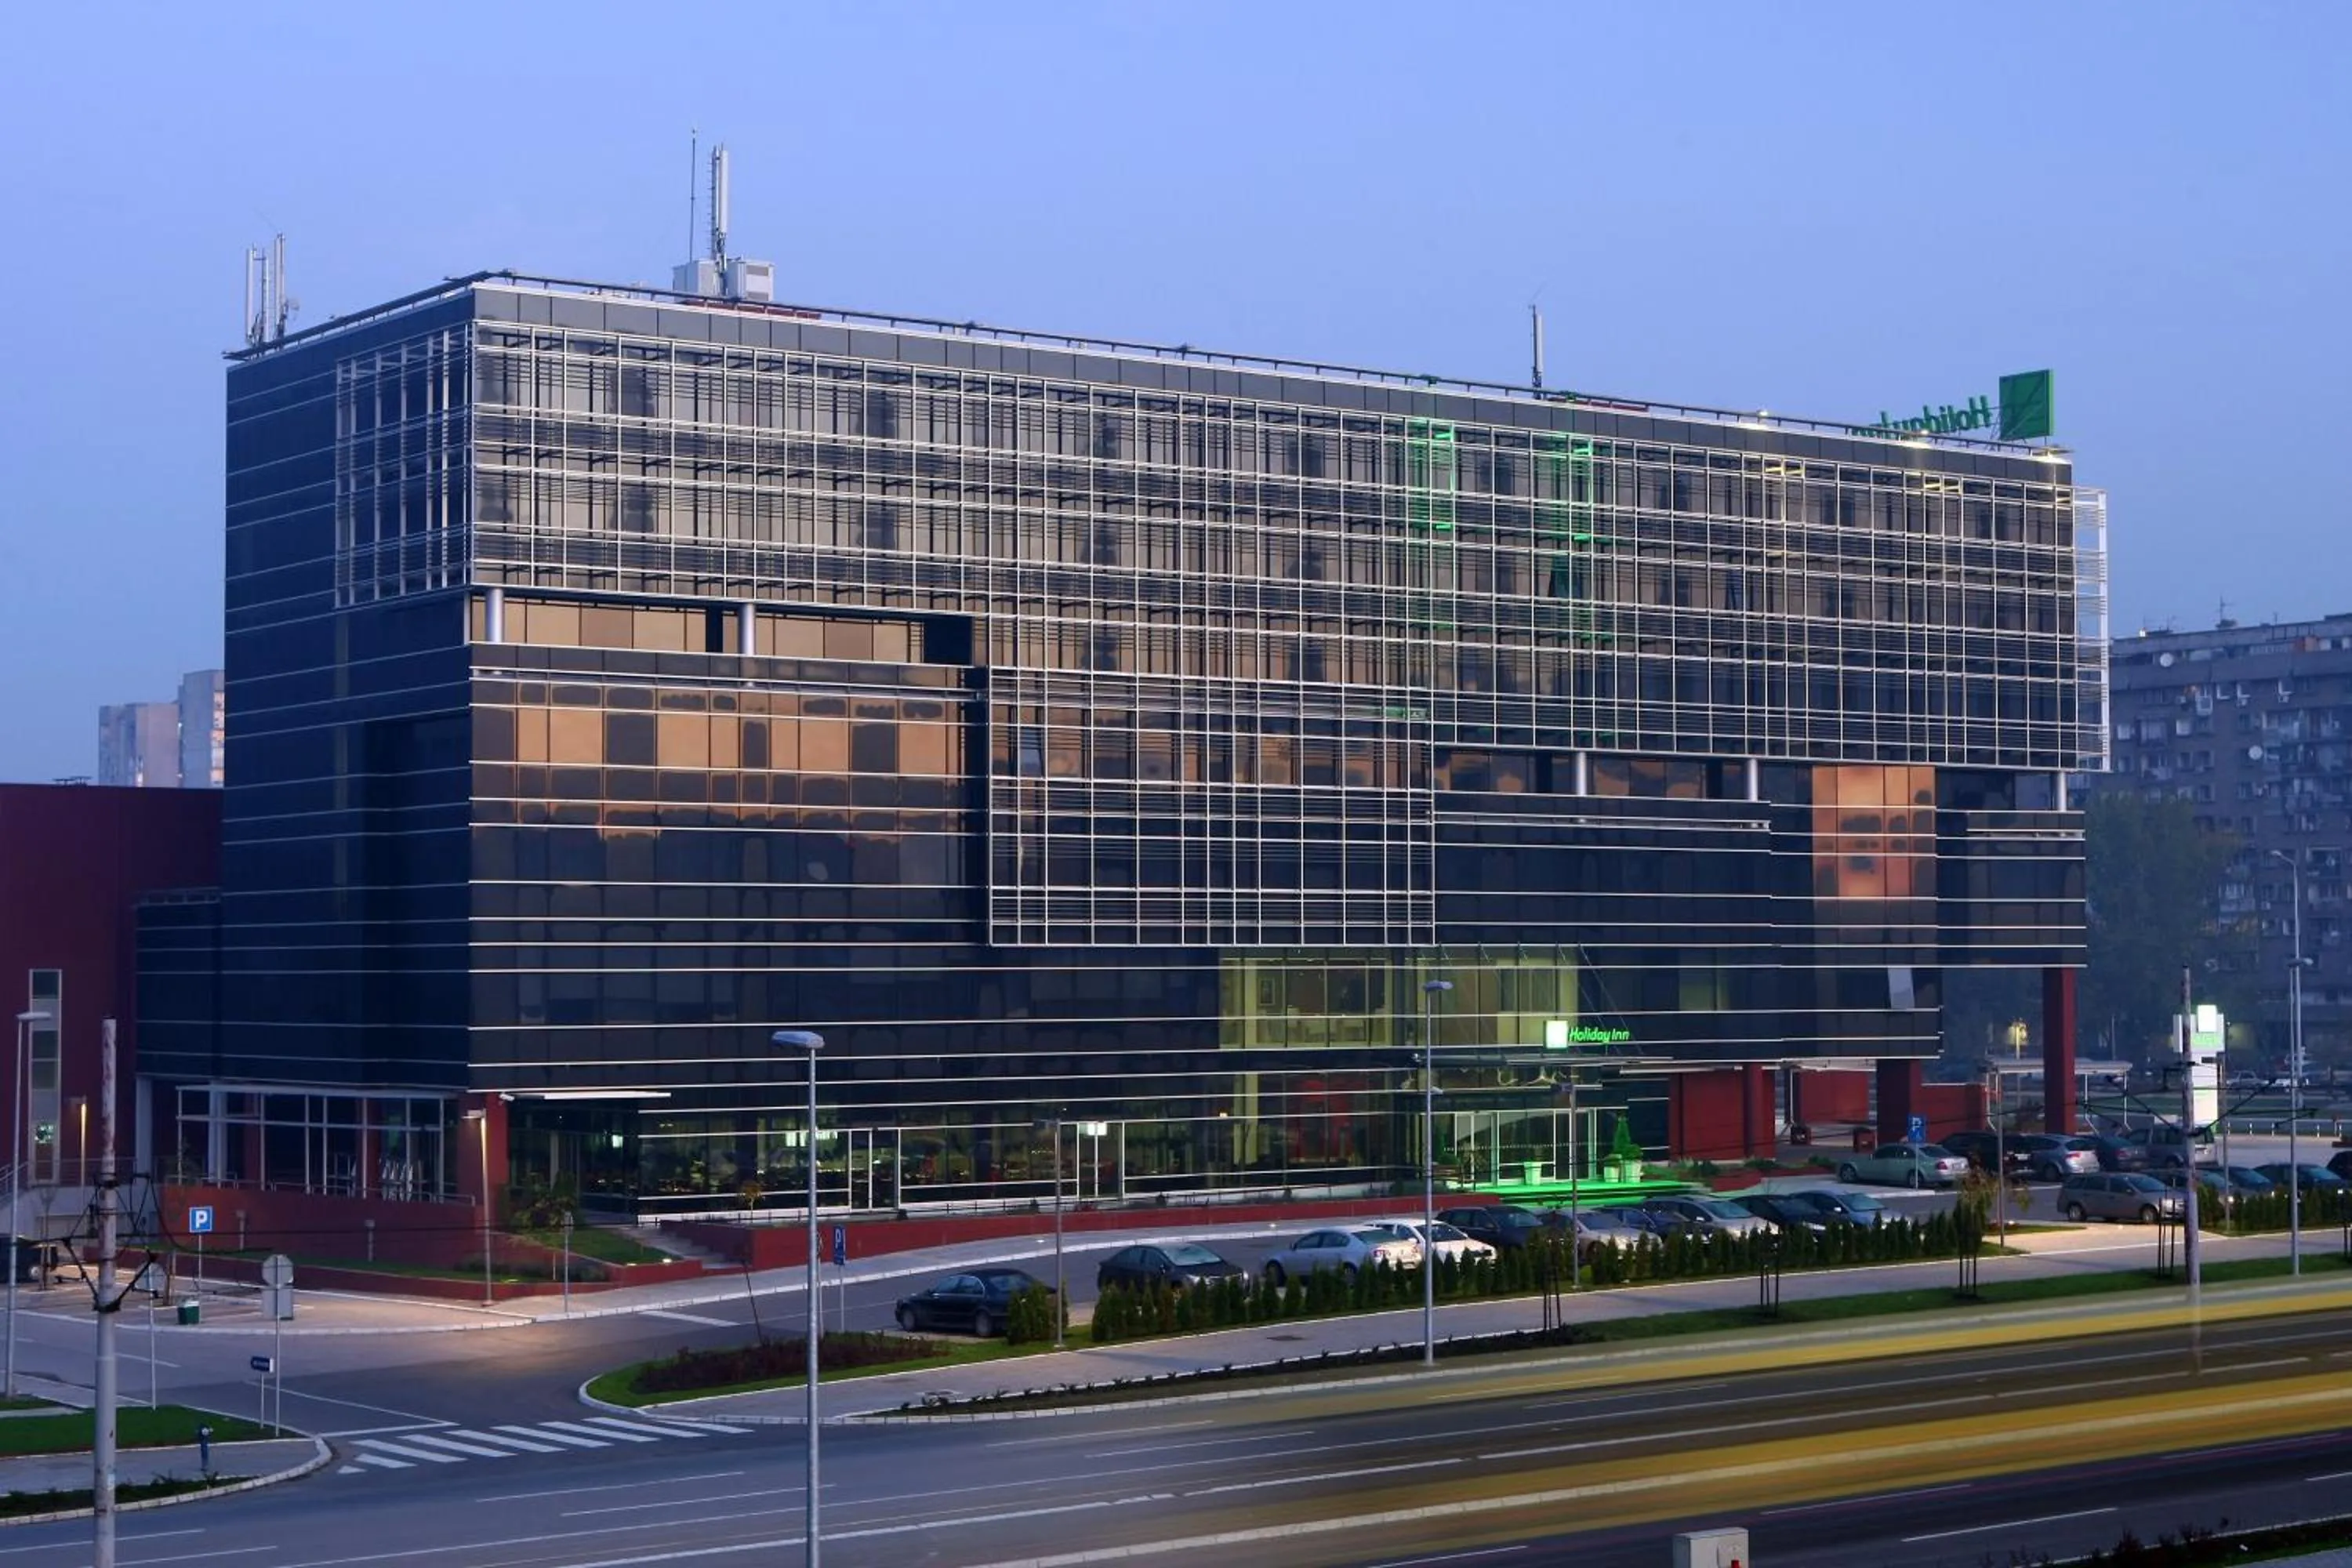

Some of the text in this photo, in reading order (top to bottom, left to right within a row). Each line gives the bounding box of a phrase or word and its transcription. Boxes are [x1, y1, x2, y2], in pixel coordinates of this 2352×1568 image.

[1569, 1026, 1630, 1044] Holiday Inn
[196, 1210, 207, 1229] P
[835, 1229, 841, 1249] P
